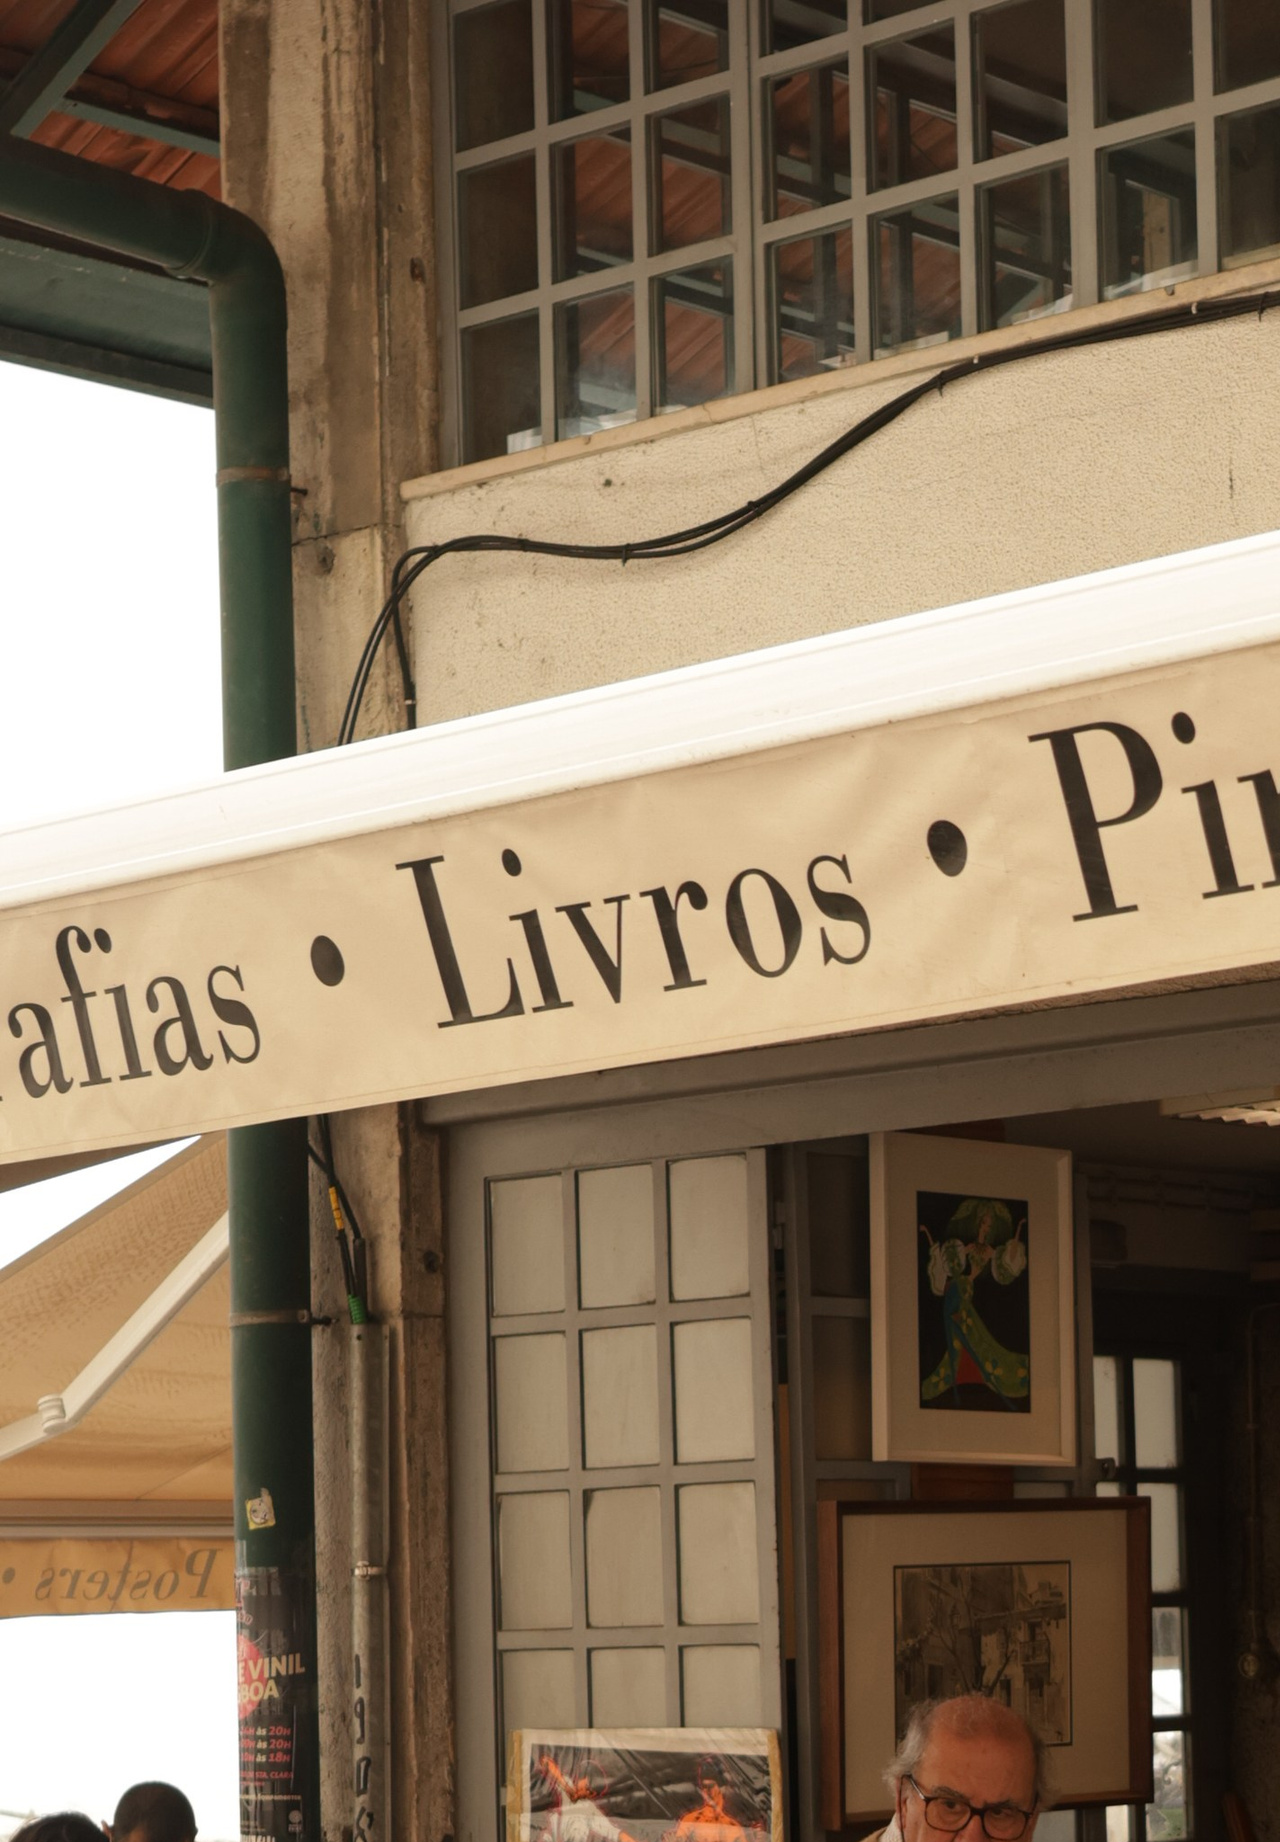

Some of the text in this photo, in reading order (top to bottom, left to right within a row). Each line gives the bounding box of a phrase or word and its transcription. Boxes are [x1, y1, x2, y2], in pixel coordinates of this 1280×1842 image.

[0, 922, 261, 1105] afias
[396, 847, 872, 1029] Livros
[249, 1652, 306, 1682] VINIL
[238, 1678, 280, 1705] BOA
[269, 1726, 291, 1736] 20H
[269, 1739, 292, 1749] 20H
